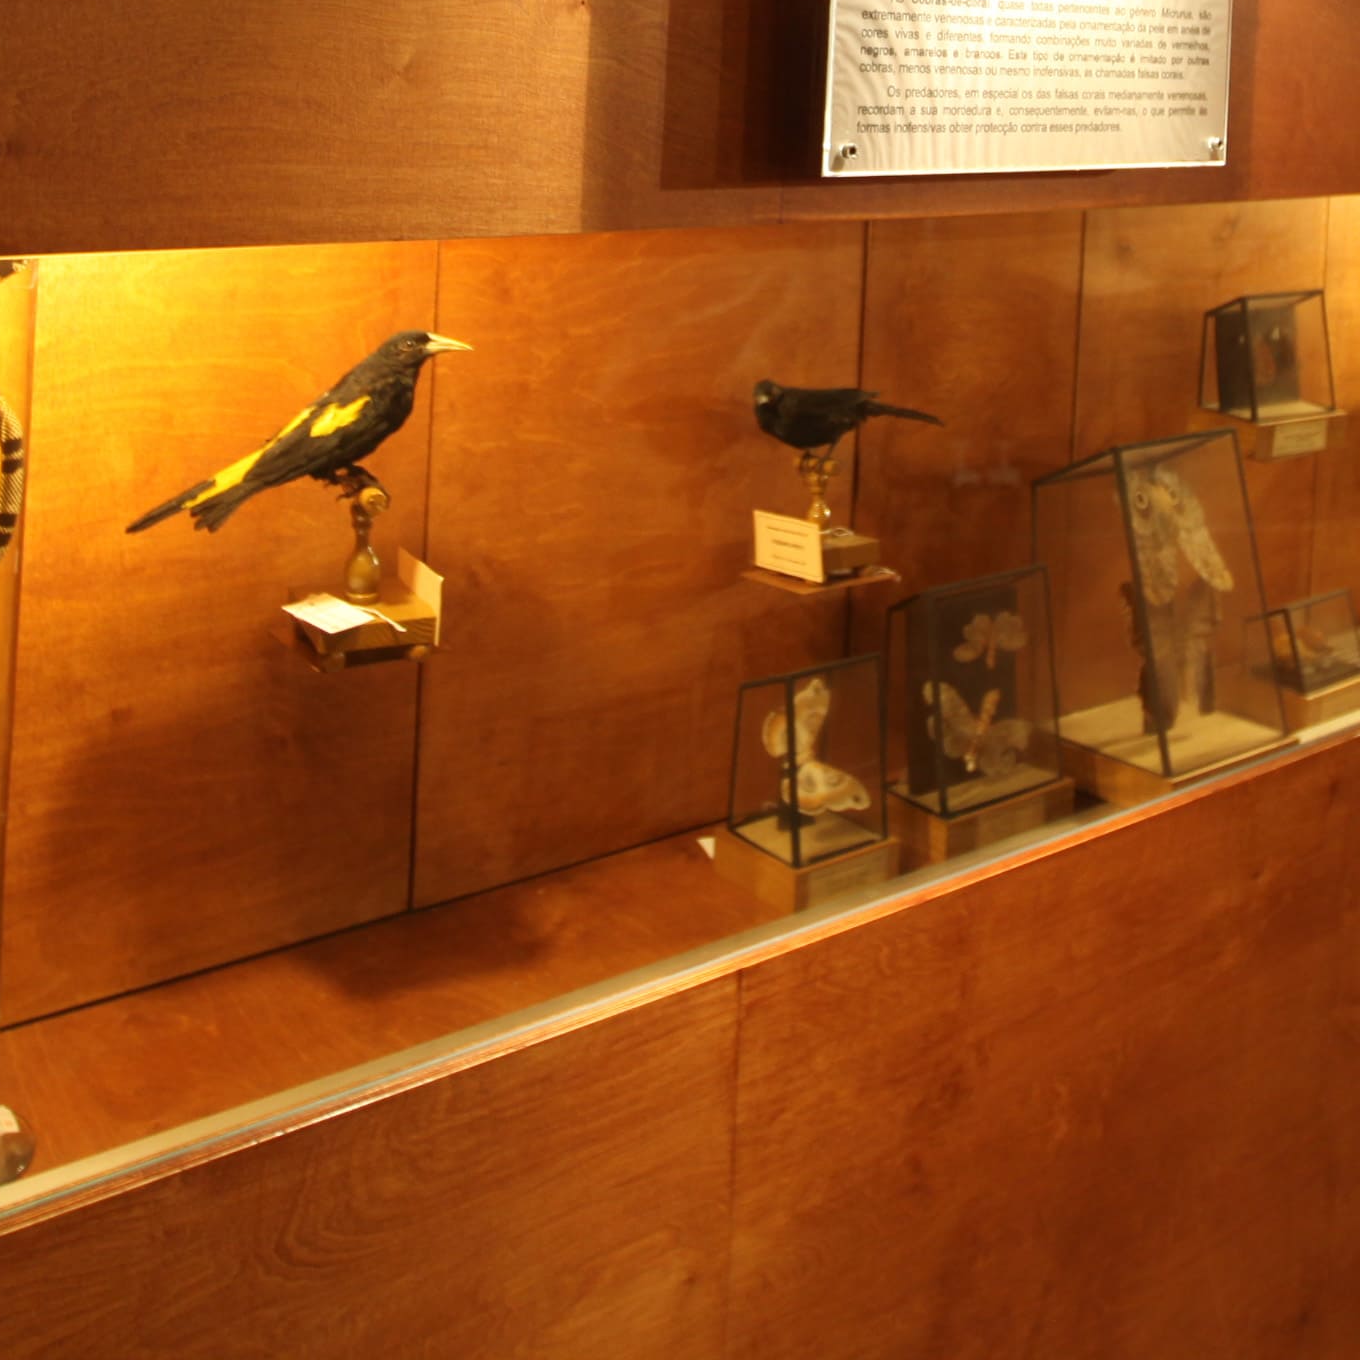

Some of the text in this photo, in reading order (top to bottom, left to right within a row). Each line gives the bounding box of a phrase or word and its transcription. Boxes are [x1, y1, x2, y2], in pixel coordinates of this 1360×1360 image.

[862, 9, 931, 23] extremamente
[935, 14, 984, 25] venenosas
[861, 28, 889, 39] cores
[895, 29, 920, 40] vivas
[990, 32, 1031, 44] formando
[1036, 34, 1089, 48] combinações
[1122, 38, 1153, 49] variadas
[860, 45, 897, 58] negros,
[904, 46, 948, 57] amarelos
[1008, 49, 1027, 60] Este
[1033, 51, 1048, 62] tipo
[1054, 51, 1064, 61] de
[859, 61, 896, 74] cobras,
[898, 64, 931, 74] menos
[935, 65, 983, 75] venenosas
[985, 66, 997, 75] ou
[1000, 67, 1030, 76] mesmo
[1095, 68, 1135, 79] chamadas
[887, 85, 901, 97] Os
[965, 89, 979, 97] em
[982, 87, 1018, 101] especial
[1021, 90, 1033, 98] os
[1036, 89, 1050, 99] das
[1055, 88, 1078, 99] falsas
[857, 104, 904, 115] recordam
[921, 106, 938, 115] sua
[1151, 107, 1164, 117] que
[856, 122, 890, 133] formas
[894, 121, 946, 133] inofensivas
[949, 122, 972, 133] obter
[1049, 124, 1073, 132] esses
